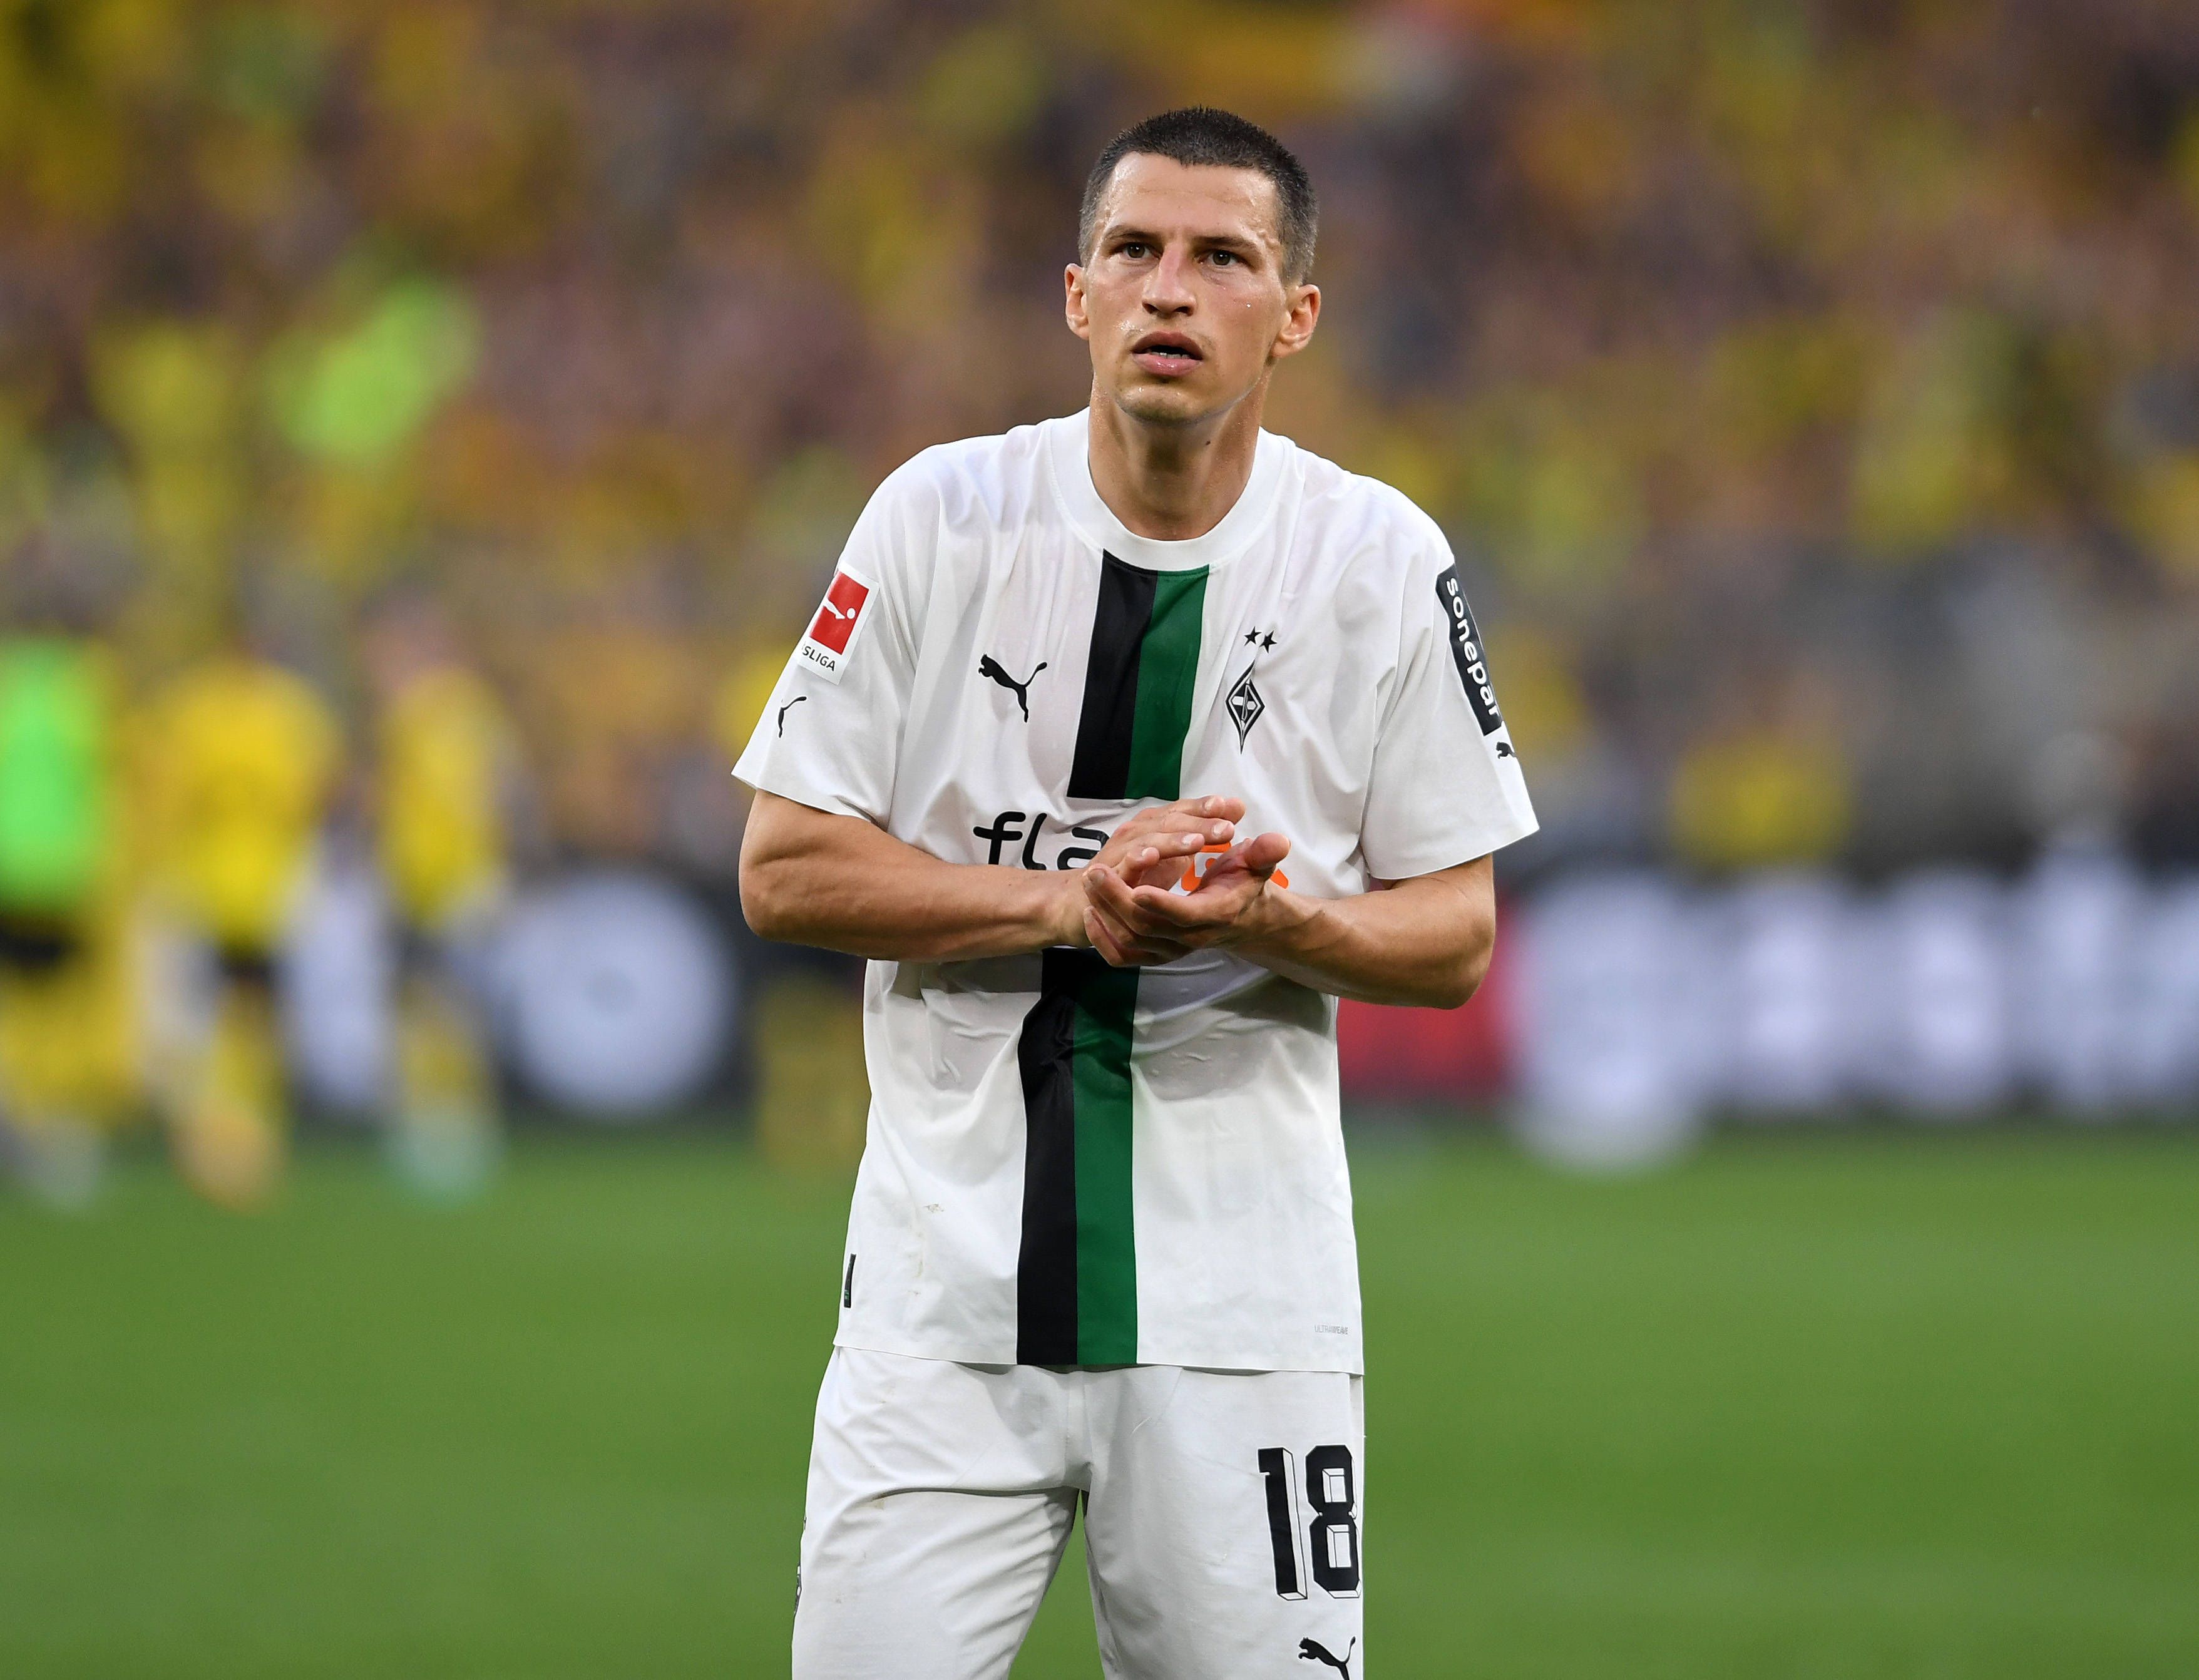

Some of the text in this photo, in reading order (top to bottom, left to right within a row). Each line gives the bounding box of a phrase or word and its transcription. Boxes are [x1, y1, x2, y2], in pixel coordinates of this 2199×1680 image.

[801, 642, 836, 672] SLIGA
[1447, 577, 1500, 717] sonepar
[1258, 1445, 1361, 1601] 18
